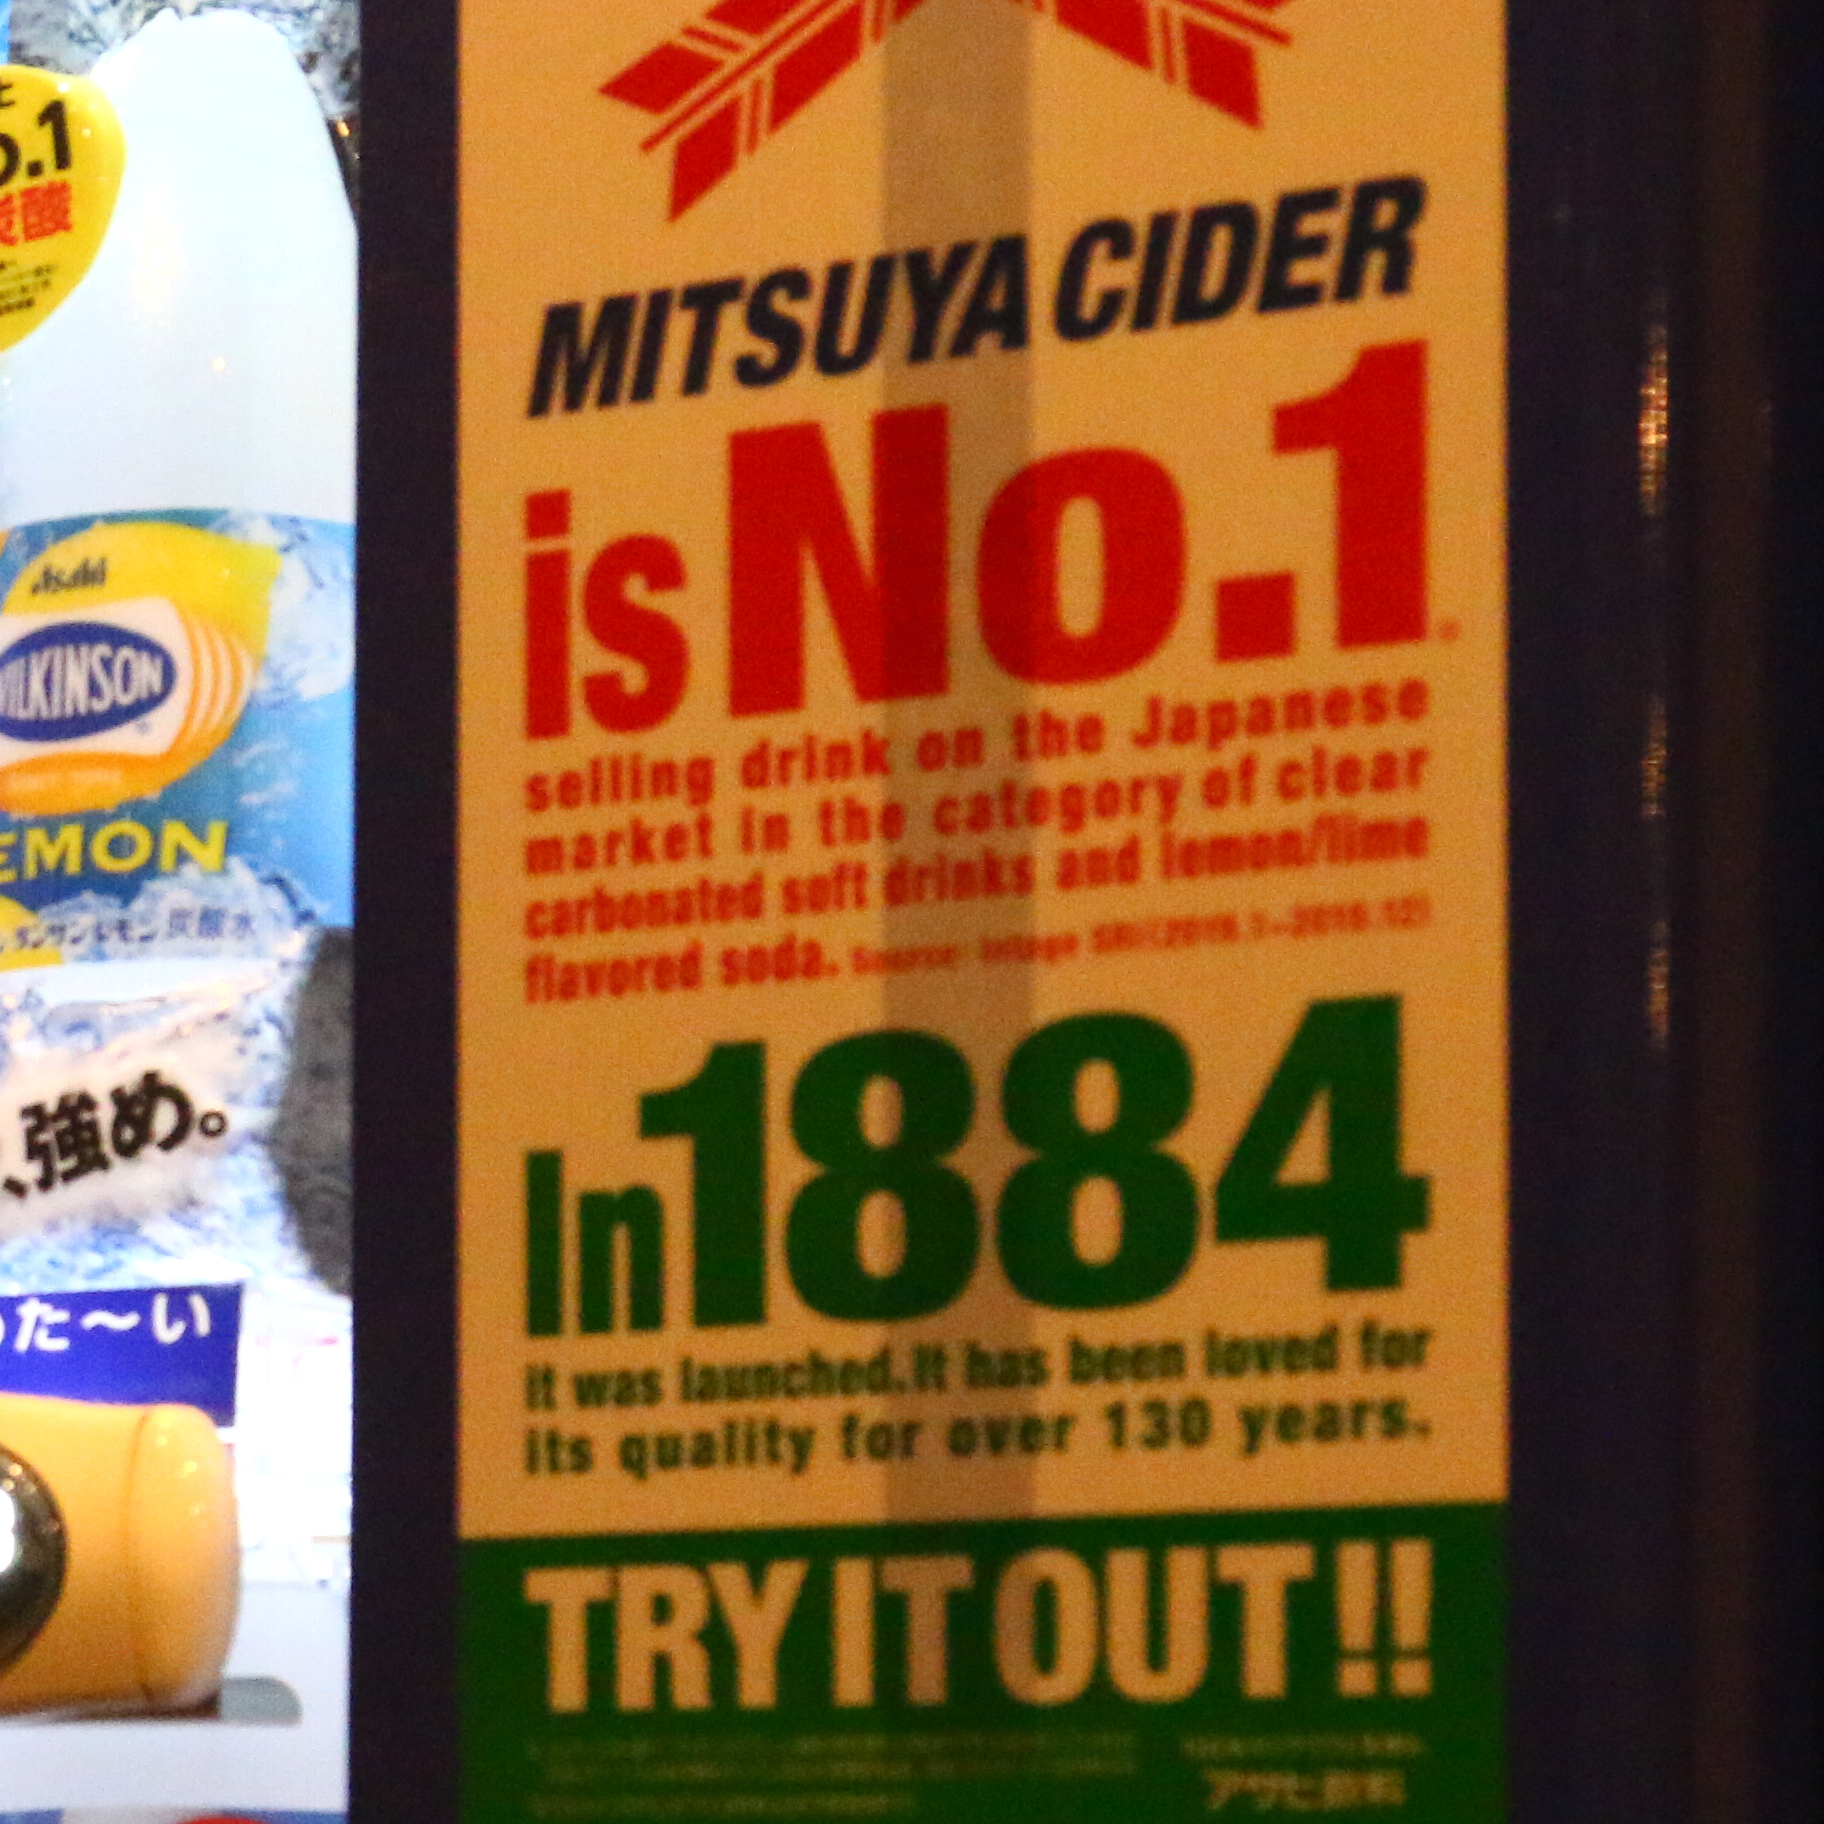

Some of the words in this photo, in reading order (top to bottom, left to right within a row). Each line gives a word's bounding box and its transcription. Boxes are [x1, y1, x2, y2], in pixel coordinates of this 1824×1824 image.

[525, 234, 1030, 419] MITSUYA
[1052, 176, 1428, 340] CIDER
[524, 487, 689, 740] is
[728, 337, 1430, 720] No.1
[525, 751, 714, 813] selling
[740, 728, 891, 789] drink
[916, 727, 983, 772] on
[1013, 709, 1105, 761] the
[1132, 676, 1429, 751] Japanese
[525, 812, 713, 874] market
[741, 804, 790, 855] in
[820, 794, 905, 847] the
[935, 775, 1183, 836] category
[1202, 752, 1257, 809] of
[1276, 745, 1429, 803] clear
[525, 869, 763, 939] carbonated
[782, 862, 868, 915] soft
[887, 847, 1035, 906] drinks
[1057, 832, 1141, 890] and
[525, 940, 703, 1002] flavored
[525, 1148, 665, 1337] In
[637, 994, 1431, 1328] 1884
[1360, 1318, 1432, 1369] for
[619, 1416, 815, 1481] quality
[842, 1411, 923, 1461] for
[949, 1411, 1075, 1459] over
[1105, 1397, 1211, 1451] 130
[1238, 1399, 1431, 1457] years.
[524, 1557, 810, 1715] TRY
[831, 1553, 974, 1709] IT
